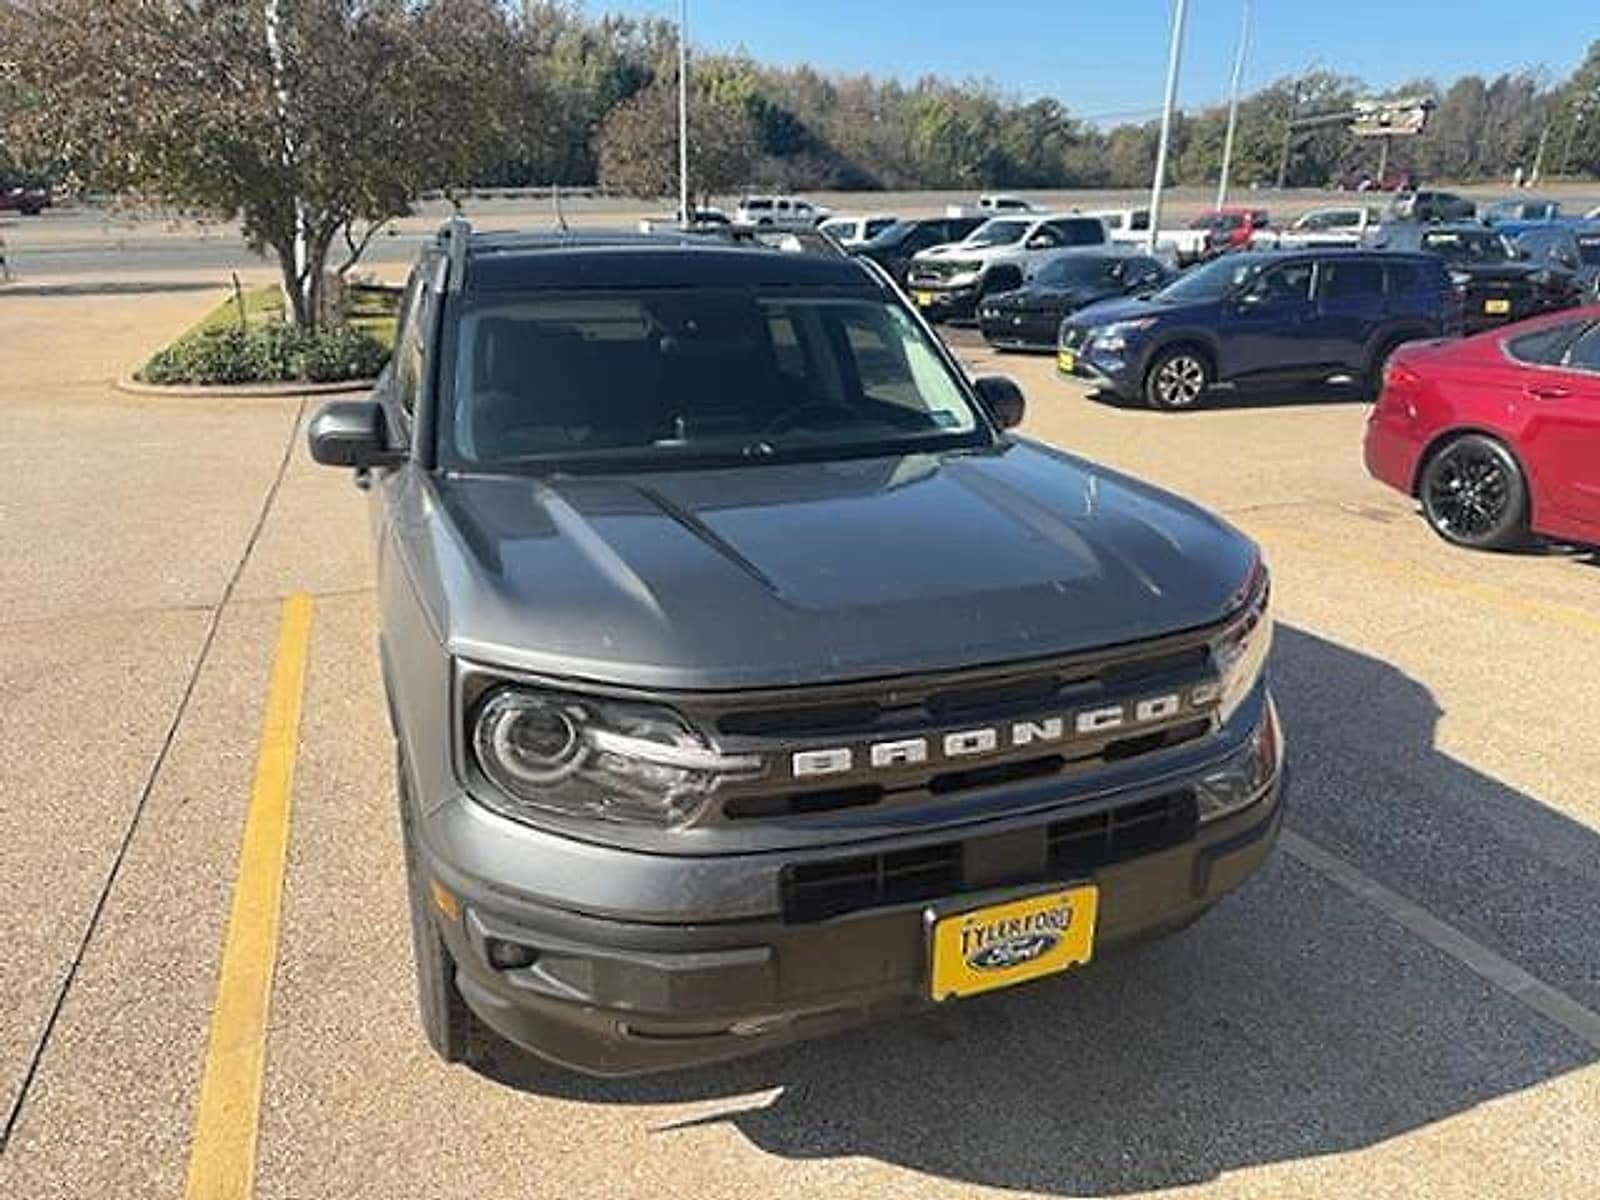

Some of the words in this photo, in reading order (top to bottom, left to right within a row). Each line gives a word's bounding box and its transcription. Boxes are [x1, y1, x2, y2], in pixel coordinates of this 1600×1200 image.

[792, 695, 1179, 777] BRONCO
[961, 919, 1022, 955] TYLER
[1024, 906, 1073, 932] FORD
